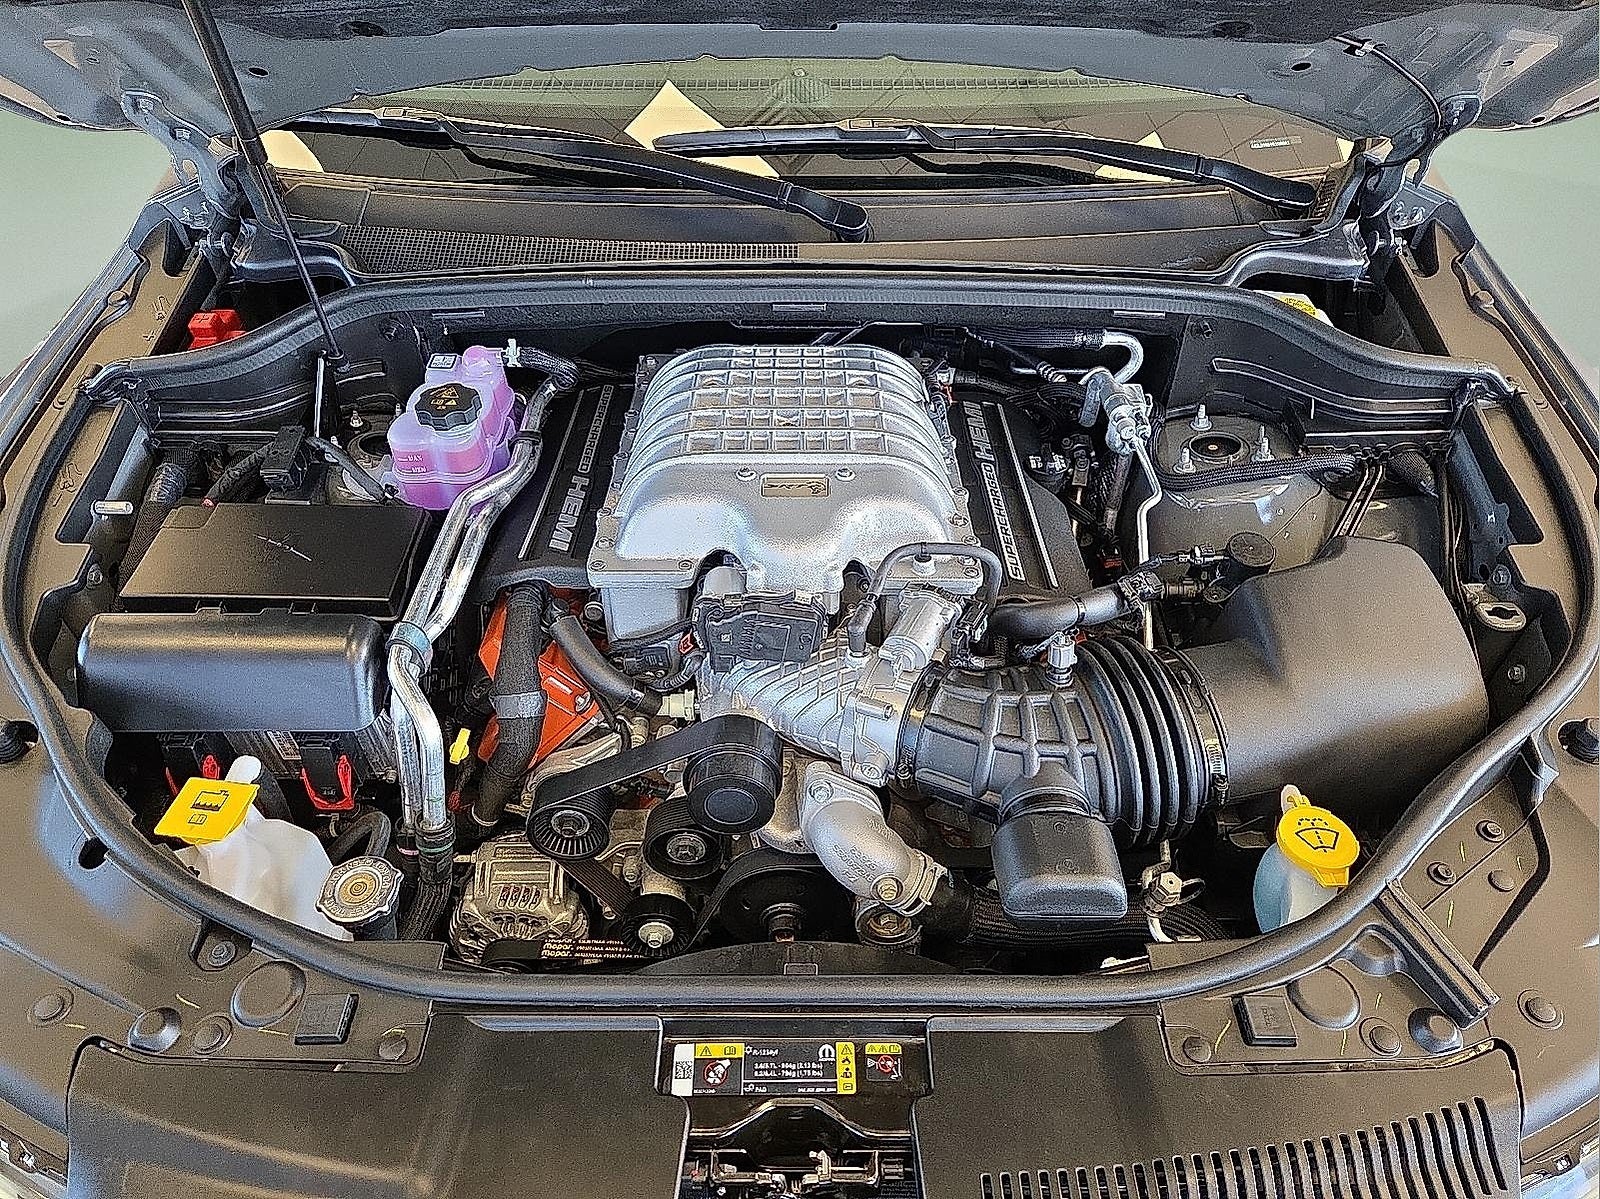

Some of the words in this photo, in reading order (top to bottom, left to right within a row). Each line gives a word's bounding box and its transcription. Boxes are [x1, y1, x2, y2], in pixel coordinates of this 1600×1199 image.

[578, 384, 614, 473] SUPERCHARGED
[963, 401, 995, 461] HEMI
[549, 475, 590, 551] HEMI
[981, 462, 1026, 581] SUPERCHARGED
